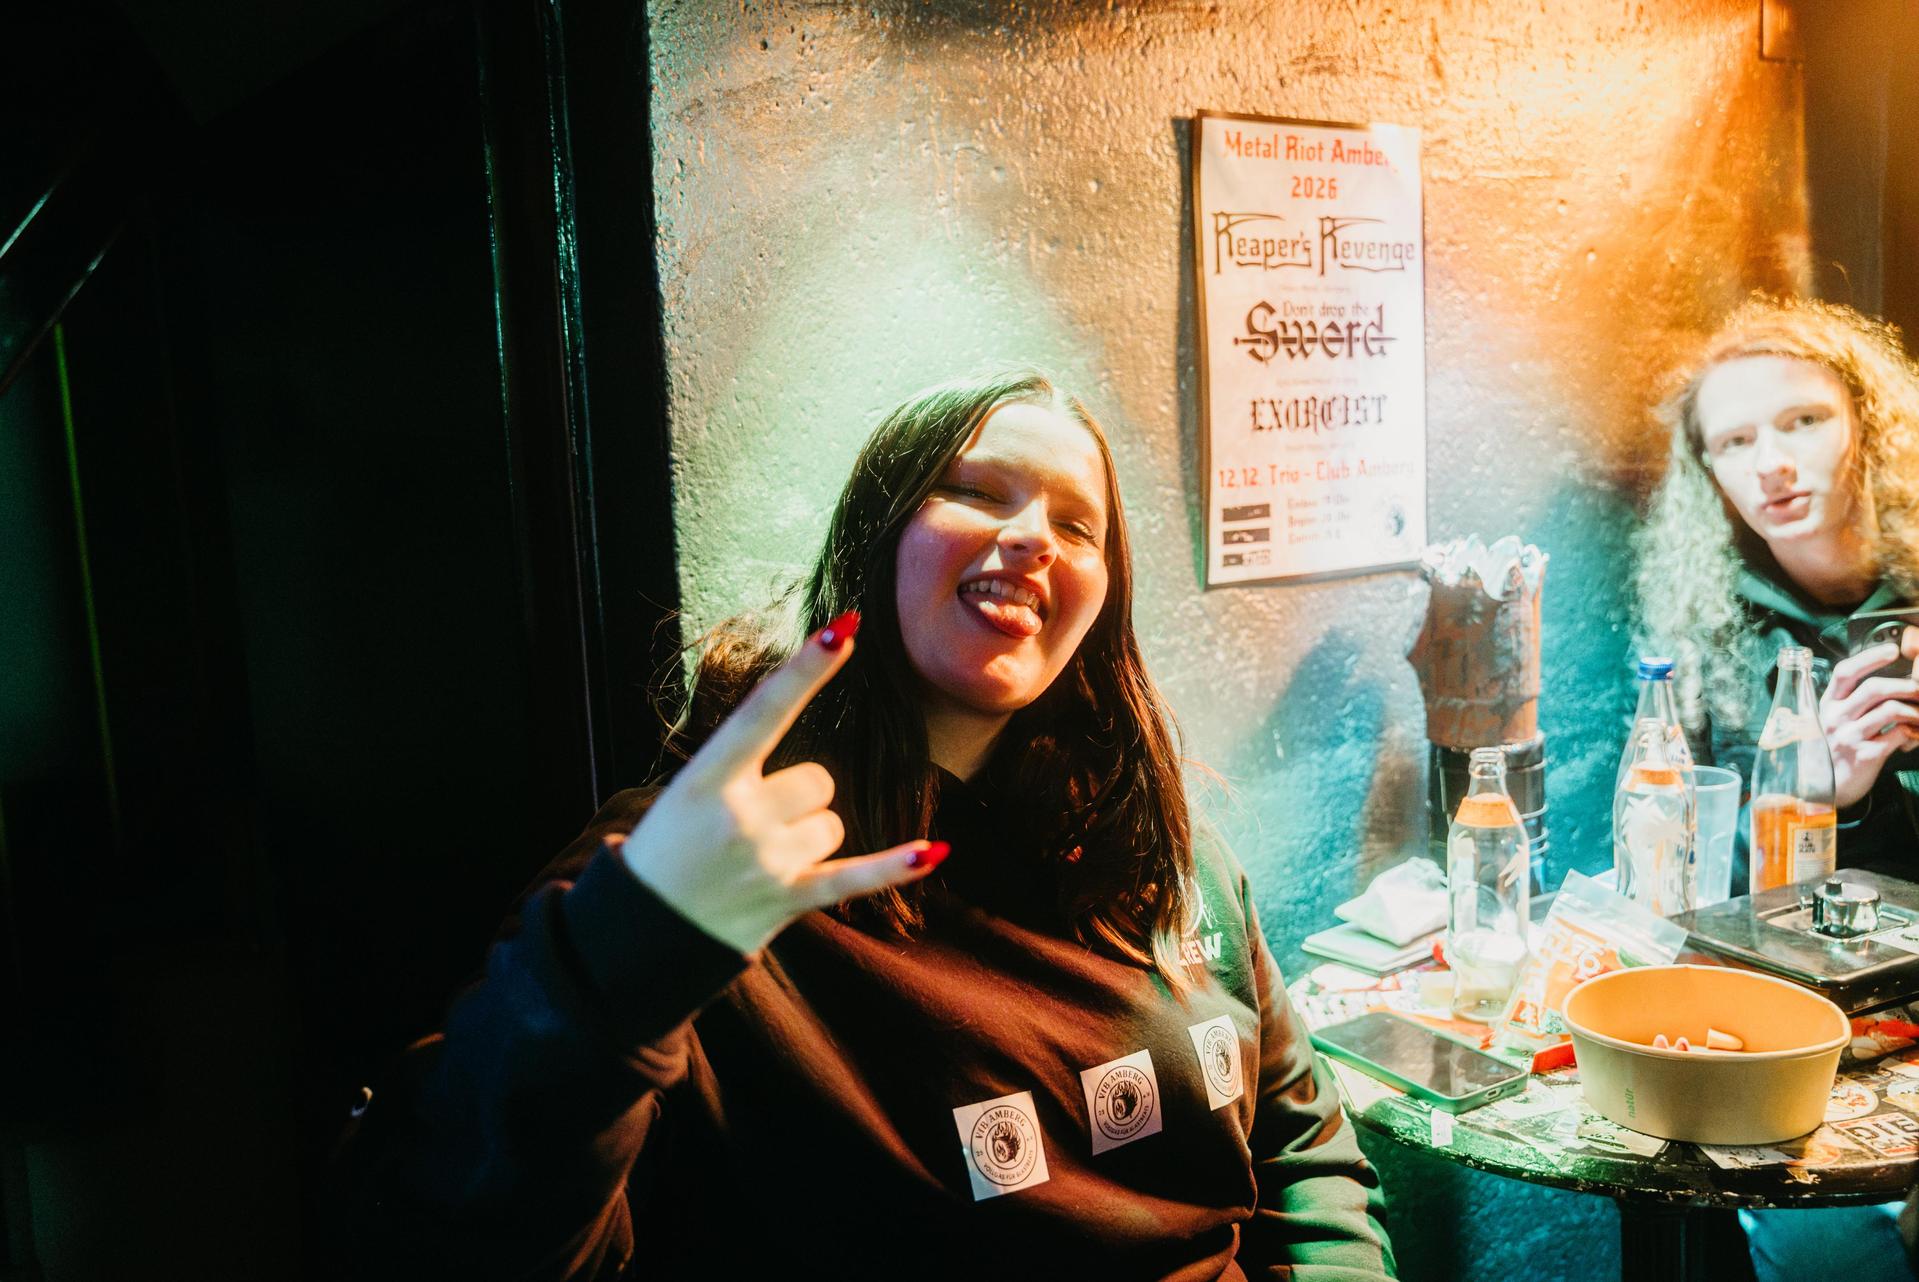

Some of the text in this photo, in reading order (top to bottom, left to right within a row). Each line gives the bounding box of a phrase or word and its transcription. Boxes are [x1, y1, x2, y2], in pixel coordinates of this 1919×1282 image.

[1224, 130, 1398, 173] Metal Riot Ambe
[1291, 175, 1338, 200] 2026
[1212, 211, 1416, 277] Reaper's Revenge
[1250, 394, 1388, 435] EXORCIST
[1315, 460, 1350, 481] Club
[1110, 1069, 1143, 1085] AMBERG
[989, 1109, 1026, 1126] AMBERG
